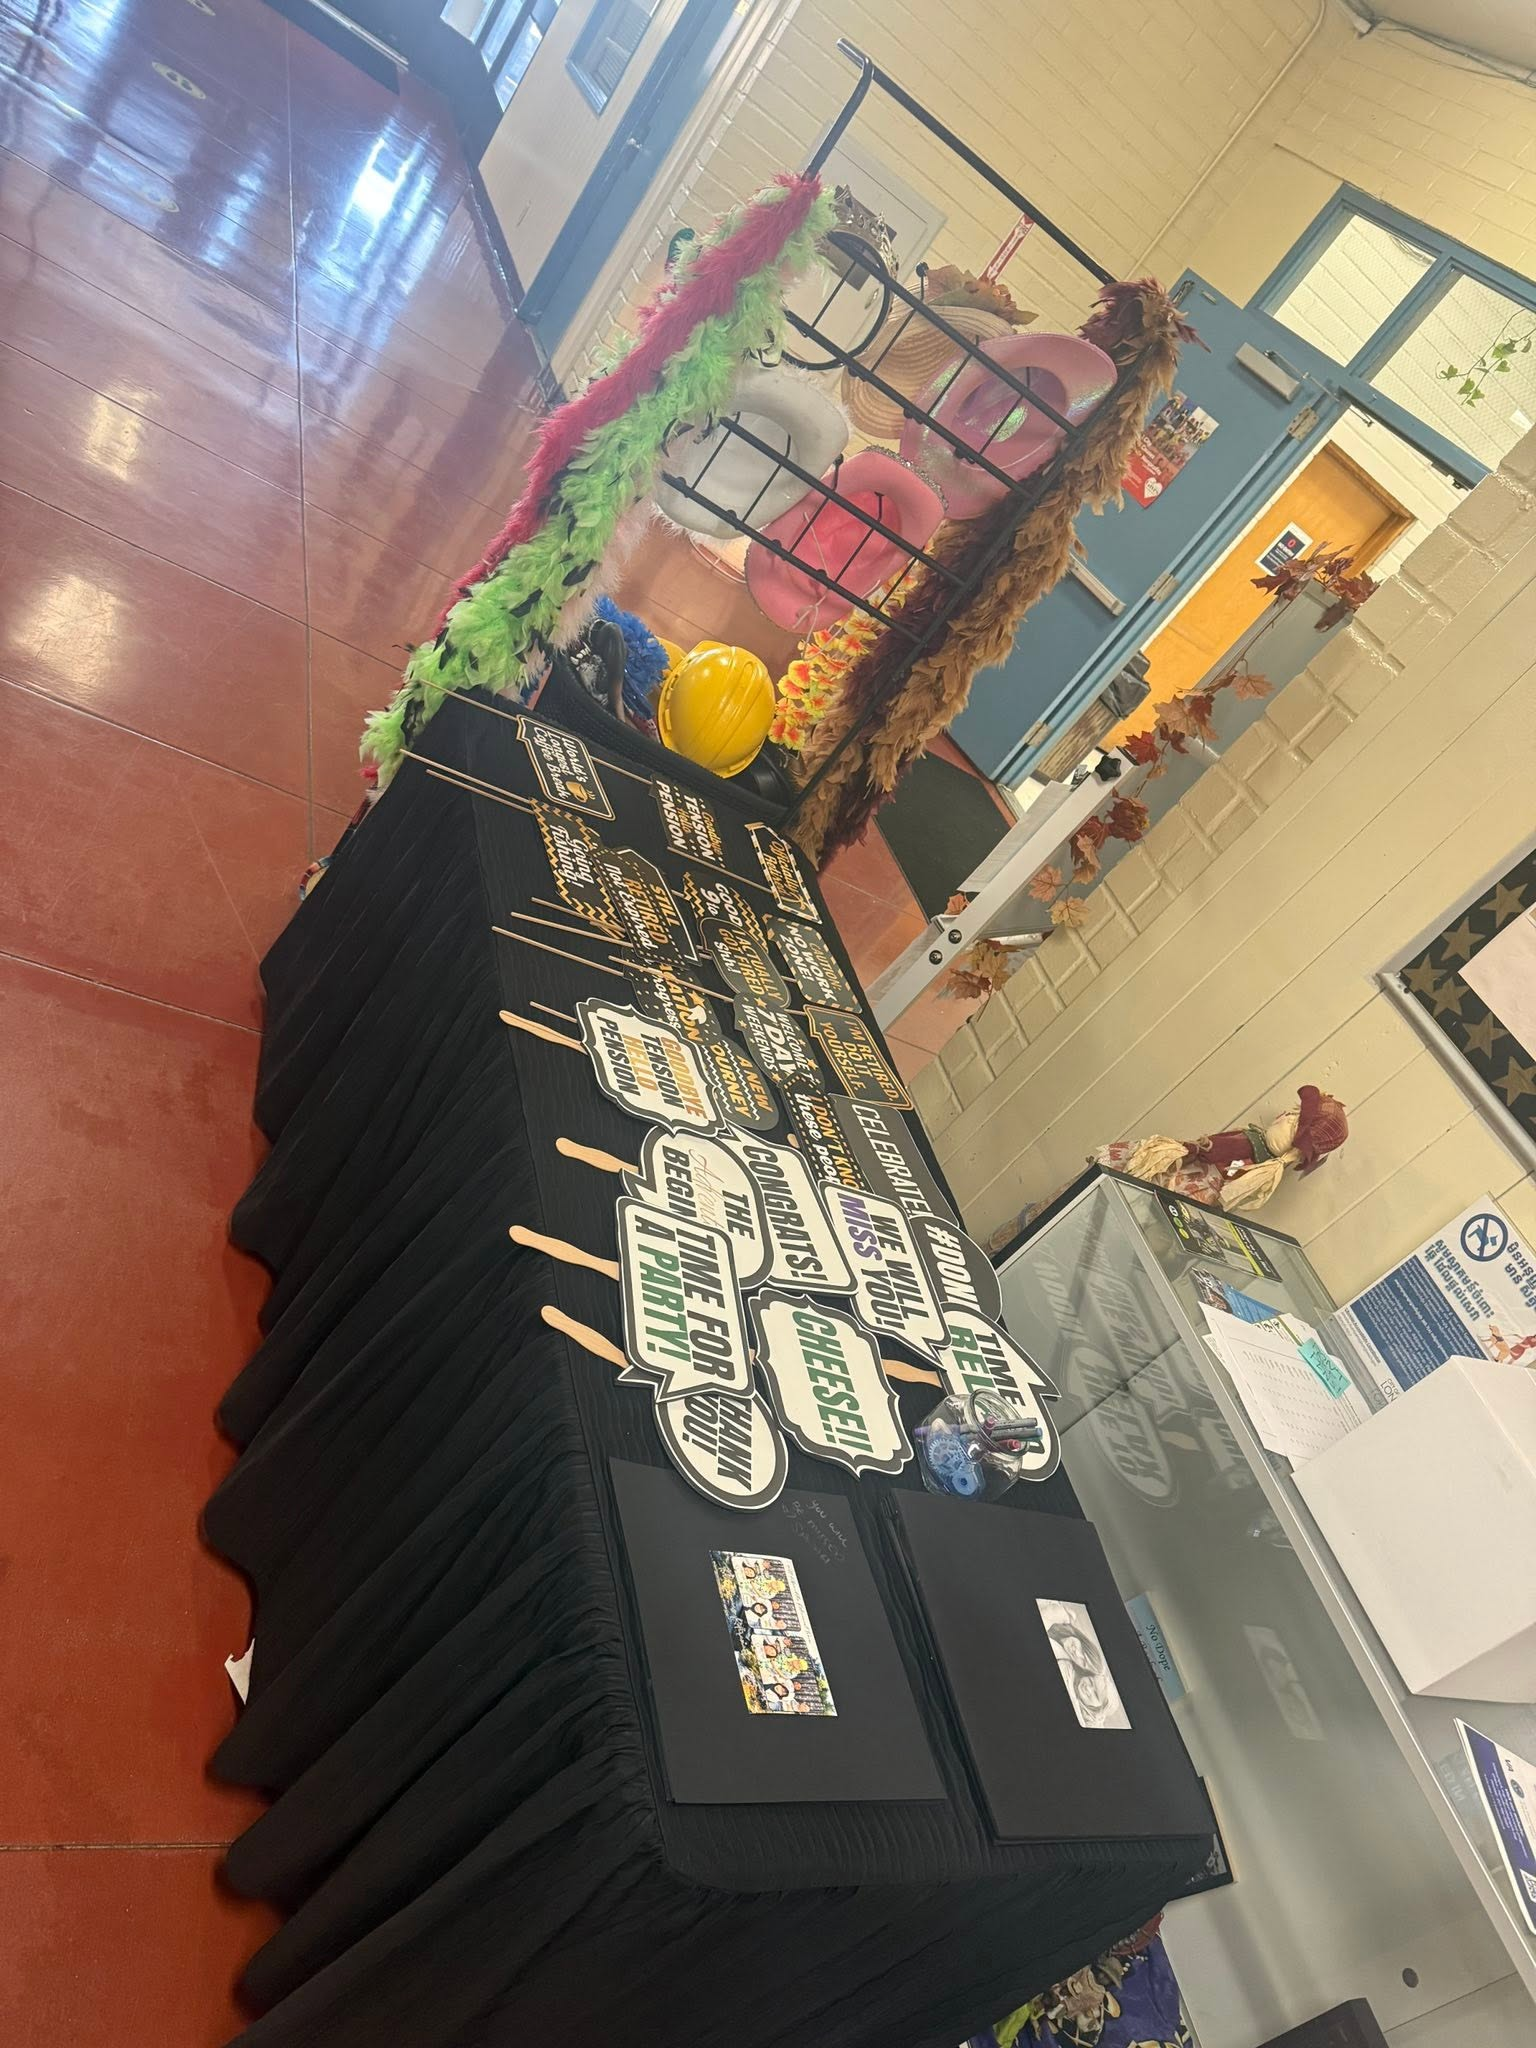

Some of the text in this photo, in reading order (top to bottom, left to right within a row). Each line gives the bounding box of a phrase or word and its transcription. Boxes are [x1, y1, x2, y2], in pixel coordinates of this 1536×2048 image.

[533, 727, 571, 800] Coffee Break
[546, 730, 575, 776] Longest
[561, 737, 588, 783] World's
[656, 780, 689, 850] PENSION
[676, 807, 694, 834] Hello
[683, 795, 716, 861] TENSION
[550, 824, 585, 888] Fishing!
[571, 838, 595, 884] Going
[604, 863, 659, 950] not Expired
[623, 877, 669, 944] RETIRED
[651, 884, 681, 926] STILL
[715, 883, 743, 927] GOOD
[714, 941, 742, 974] Shh!
[718, 928, 765, 995] GOT FIRED
[738, 935, 784, 1000] ACTUALLY
[780, 934, 815, 982] ZONE!
[786, 925, 838, 1001] NO WORK
[653, 974, 682, 1029] rogress
[844, 1020, 866, 1041] I'M
[596, 1015, 642, 1097] PENSION
[621, 1034, 659, 1092] HELLO
[640, 1033, 687, 1110] TENSION
[742, 1004, 778, 1072] WEEKENDS
[756, 1006, 796, 1075] 7 DAY
[775, 1012, 807, 1068] WELCOME
[819, 1022, 867, 1091] YOURSELF.
[843, 1041, 874, 1078] DO IT
[658, 1036, 708, 1120] GOODBYE
[710, 1042, 752, 1120] OURNEY
[736, 1055, 774, 1113] A NEW
[794, 1092, 842, 1184] these peop
[811, 1104, 845, 1156] DON'T
[833, 1154, 860, 1190] KNO
[851, 1104, 935, 1218] CELEBRATE!
[662, 1145, 698, 1217] BEGIN
[722, 1190, 756, 1240] THE
[743, 1145, 829, 1282] CONGRATS!
[634, 1214, 691, 1363] A PARTY!
[837, 1193, 906, 1330] MISS YOU!
[870, 1215, 930, 1320] WE WILL
[676, 1228, 736, 1382] TIME FOR
[792, 1310, 874, 1454] CHEESE!!
[948, 1324, 996, 1414] REL
[975, 1332, 1026, 1407] TIME
[1380, 1380, 1399, 1402] LON
[682, 1396, 719, 1457] YOU!
[717, 1396, 752, 1492] THANK
[1145, 1624, 1159, 1642] No
[1155, 1642, 1171, 1671] Dope
